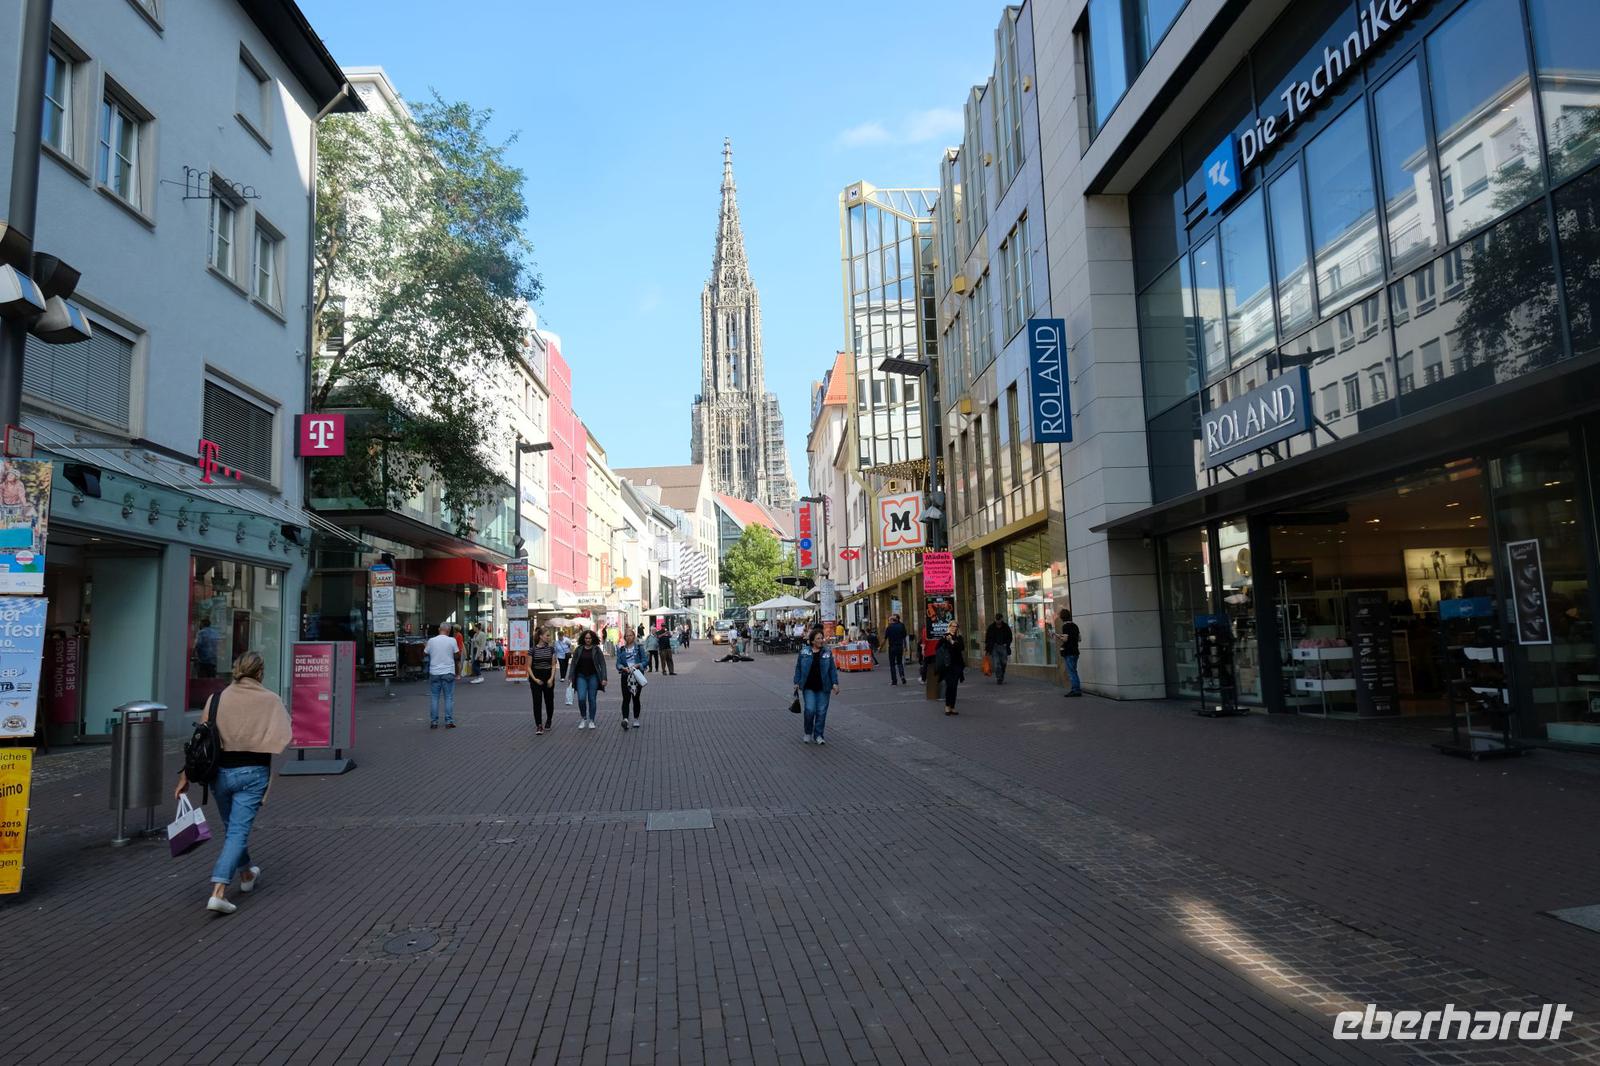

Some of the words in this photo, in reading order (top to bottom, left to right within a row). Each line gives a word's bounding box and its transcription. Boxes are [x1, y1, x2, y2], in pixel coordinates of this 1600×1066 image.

[1240, 115, 1277, 167] Die
[1281, 0, 1418, 123] Technike
[1035, 325, 1063, 435] ROLAND
[308, 420, 335, 449] T
[1206, 384, 1296, 454] ROLAND
[890, 510, 912, 533] M
[0, 609, 23, 621] er
